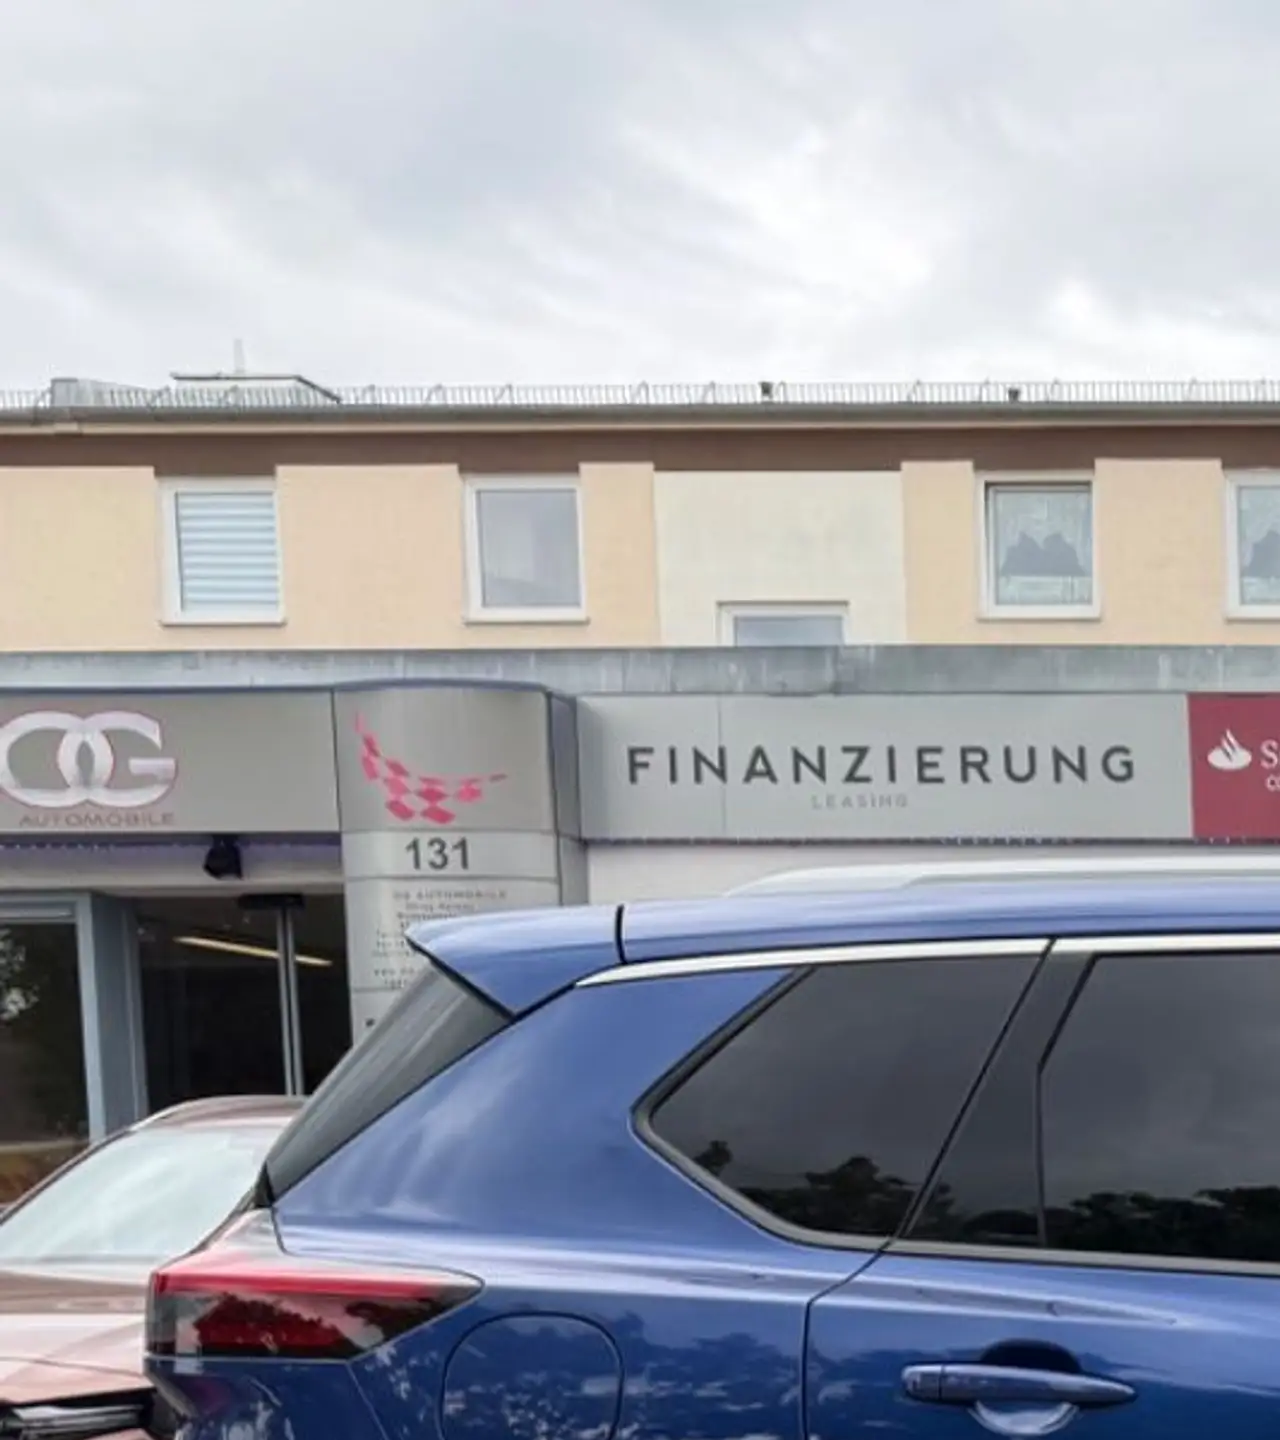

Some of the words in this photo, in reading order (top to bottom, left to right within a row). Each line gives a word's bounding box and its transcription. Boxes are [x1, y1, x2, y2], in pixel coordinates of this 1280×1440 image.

[627, 744, 1134, 785] FINANZIERUNG
[811, 793, 908, 810] LEASING
[18, 812, 175, 828] AUTOMOBILE
[405, 836, 469, 870] 131
